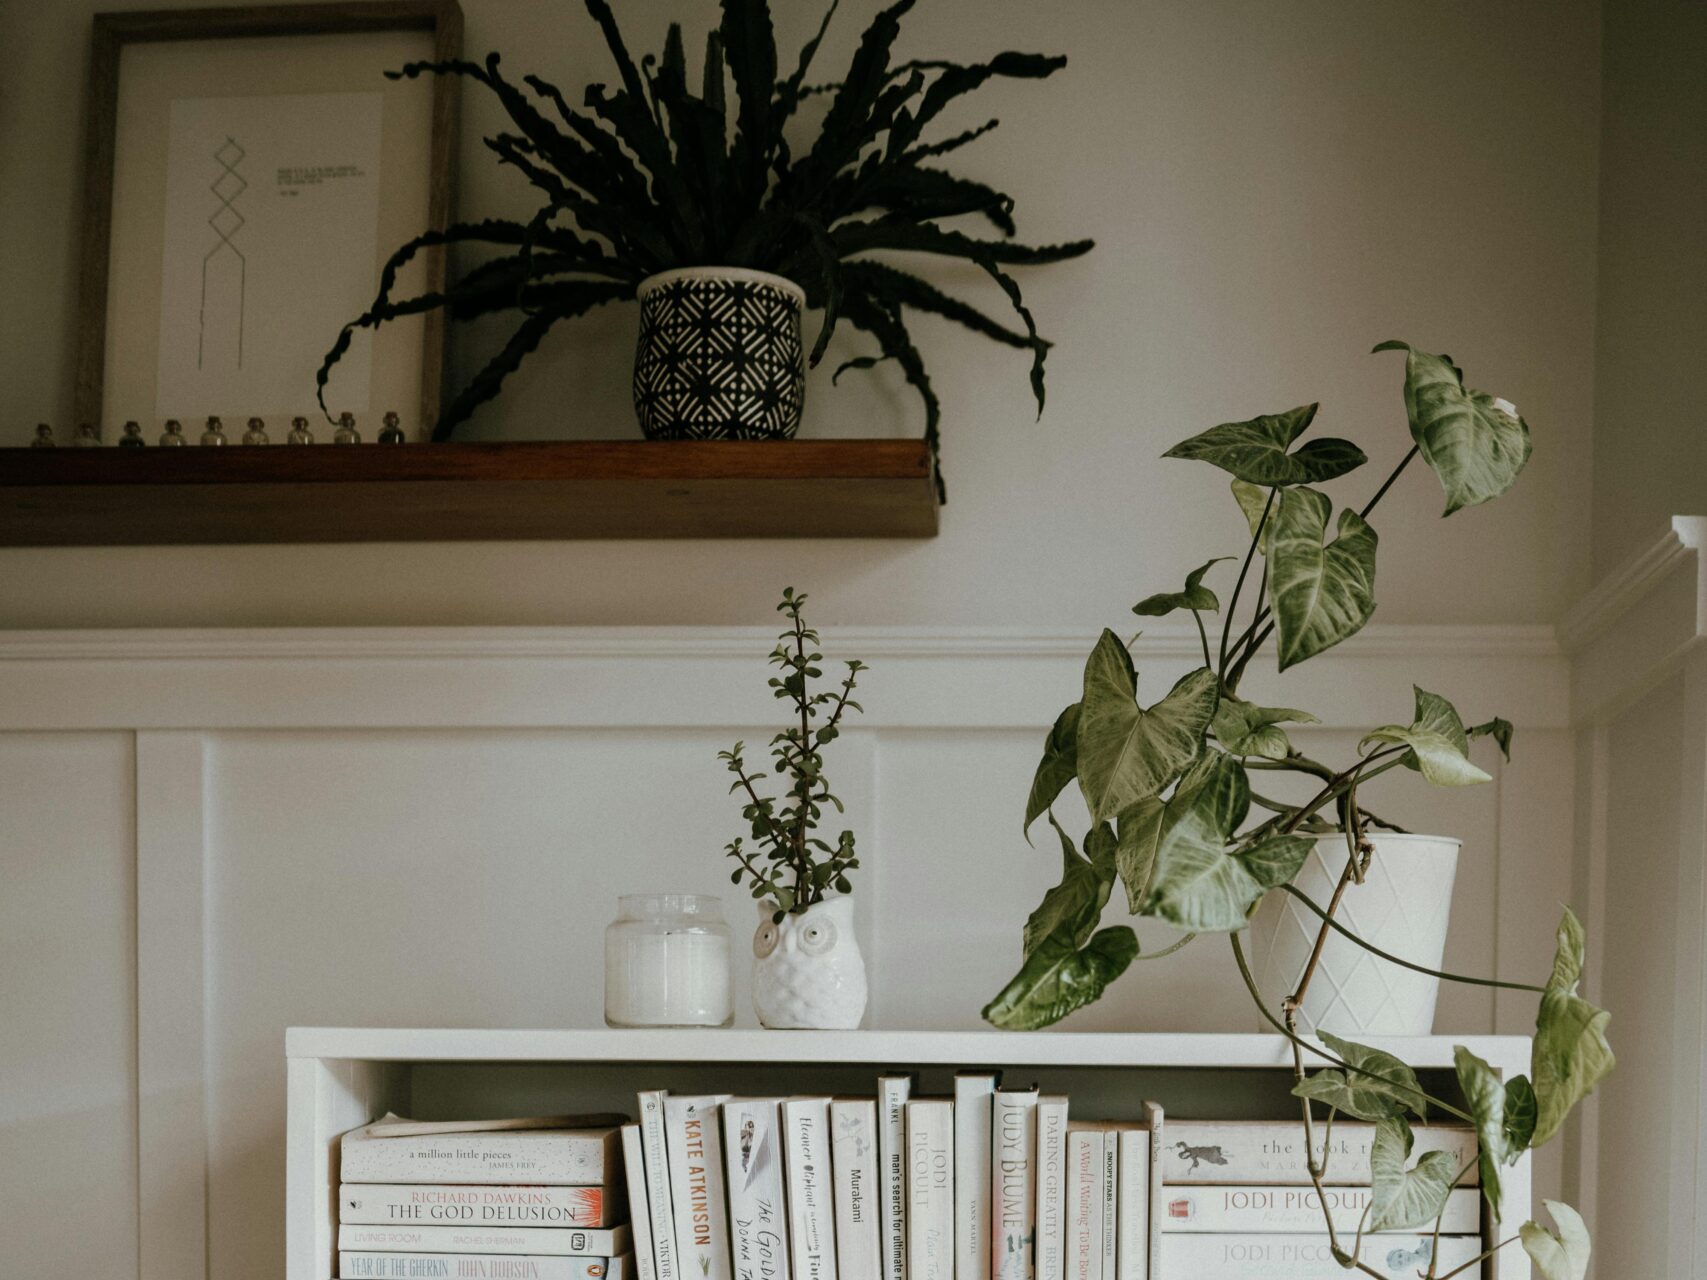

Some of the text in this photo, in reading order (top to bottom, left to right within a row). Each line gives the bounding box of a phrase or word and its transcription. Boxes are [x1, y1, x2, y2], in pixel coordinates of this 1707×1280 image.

[890, 1093, 898, 1125] FRANKL
[417, 1150, 453, 1159] million
[456, 1150, 479, 1159] little
[483, 1151, 511, 1160] pieces
[892, 1154, 903, 1181] man's
[915, 1132, 928, 1208] PICOULT
[932, 1149, 946, 1189] JODI
[1001, 1104, 1027, 1228] JUDY BLUME
[684, 1120, 711, 1245] KATE ATKINSON
[1046, 1115, 1059, 1238] DARING GREATLY
[411, 1192, 551, 1204] RICHARD DAWKINS
[850, 1169, 863, 1223] Murakami
[893, 1185, 903, 1216] search
[1106, 1203, 1112, 1211] AS
[387, 1204, 576, 1221] THE GOD DELUSION
[893, 1219, 903, 1233] for
[351, 1257, 448, 1276] YEAR OF THE GHERKIN
[893, 1235, 904, 1277] ultimate
